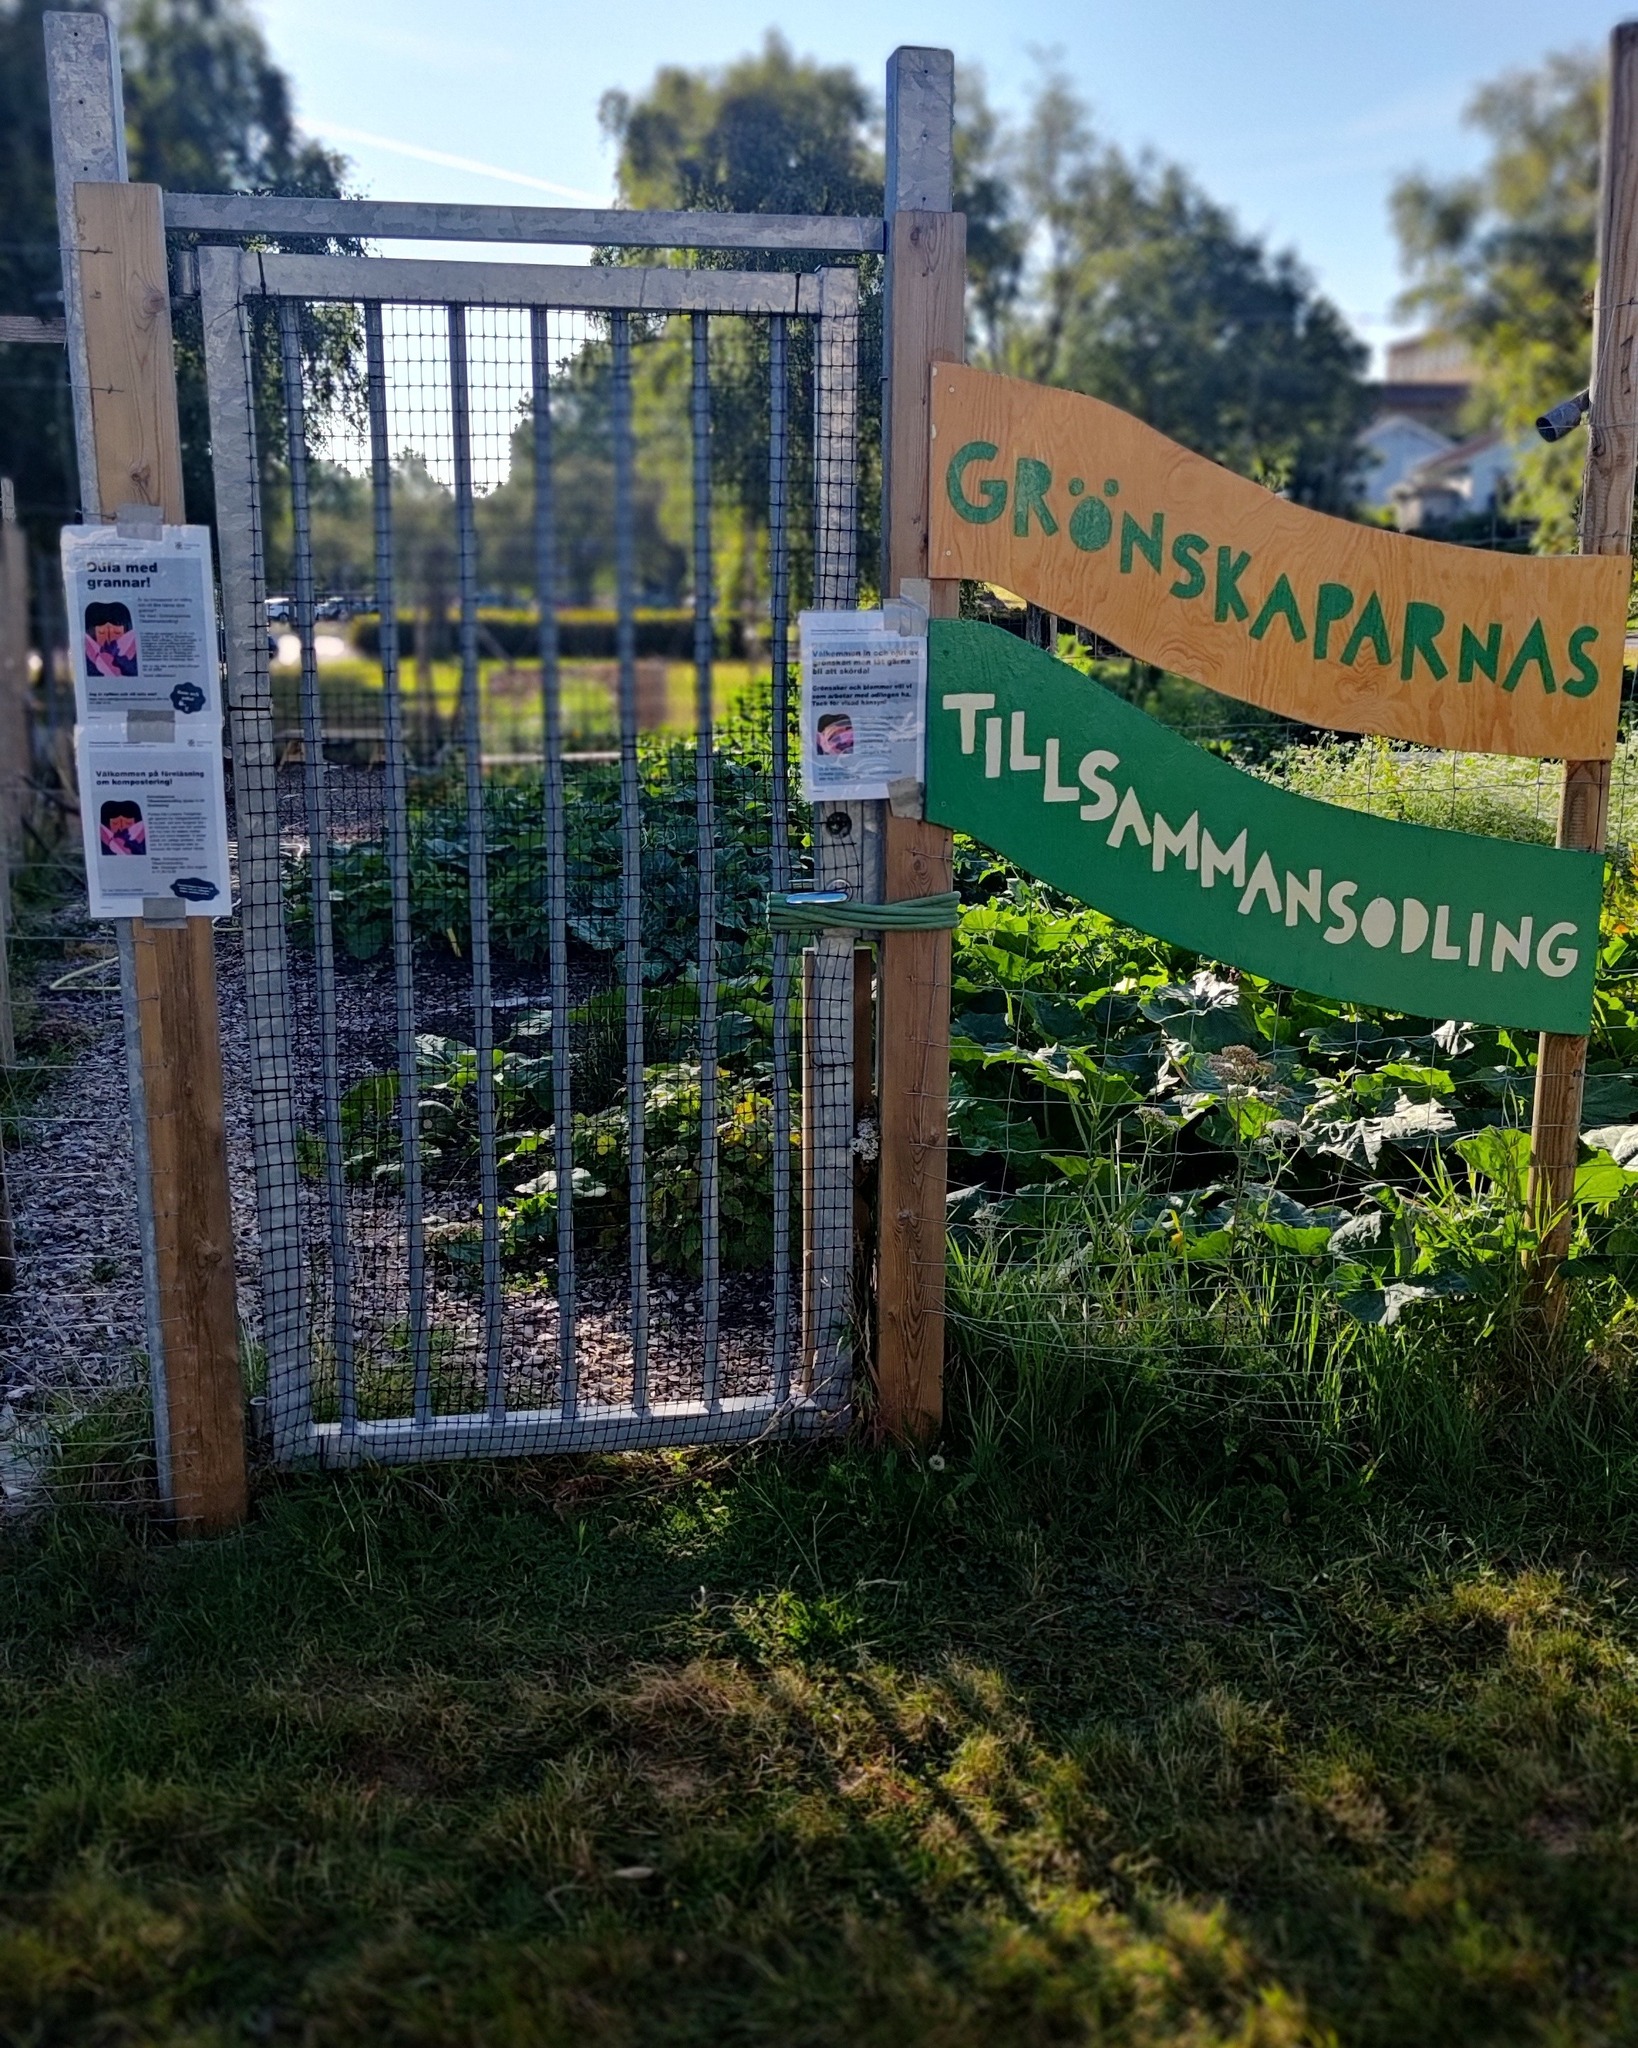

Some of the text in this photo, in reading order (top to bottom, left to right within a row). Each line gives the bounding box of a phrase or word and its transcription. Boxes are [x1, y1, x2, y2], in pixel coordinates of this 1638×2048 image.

[126, 562, 158, 573] med
[946, 441, 1599, 698] GRÖNSKAPARNAS
[87, 577, 151, 590] grannar!
[148, 770, 159, 778] på
[112, 779, 173, 787] kompostering!
[943, 693, 1578, 977] TILLSAMMANSODLING
